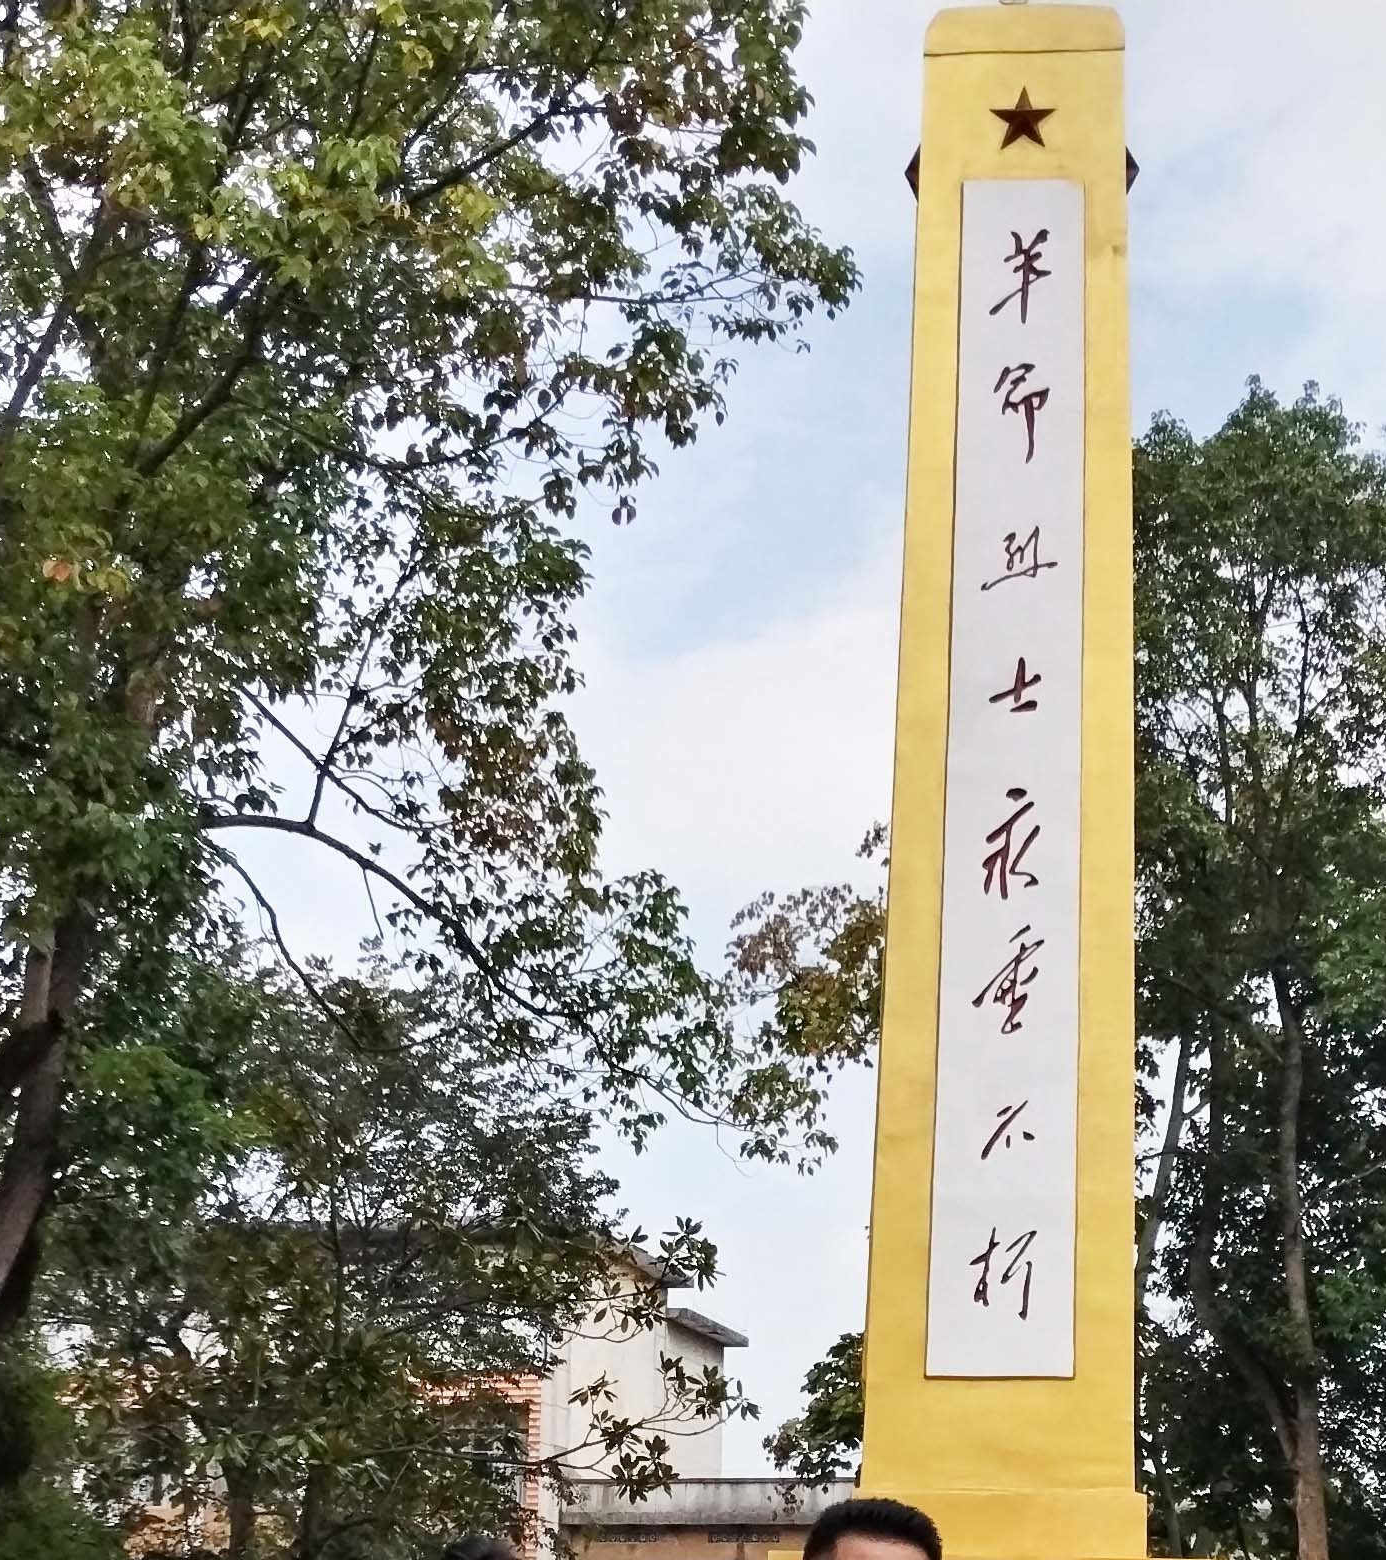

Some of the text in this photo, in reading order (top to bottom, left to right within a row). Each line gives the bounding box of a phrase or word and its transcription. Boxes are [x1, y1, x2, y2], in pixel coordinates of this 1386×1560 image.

[968, 228, 1059, 1321] 革命烈士永垂不朽
